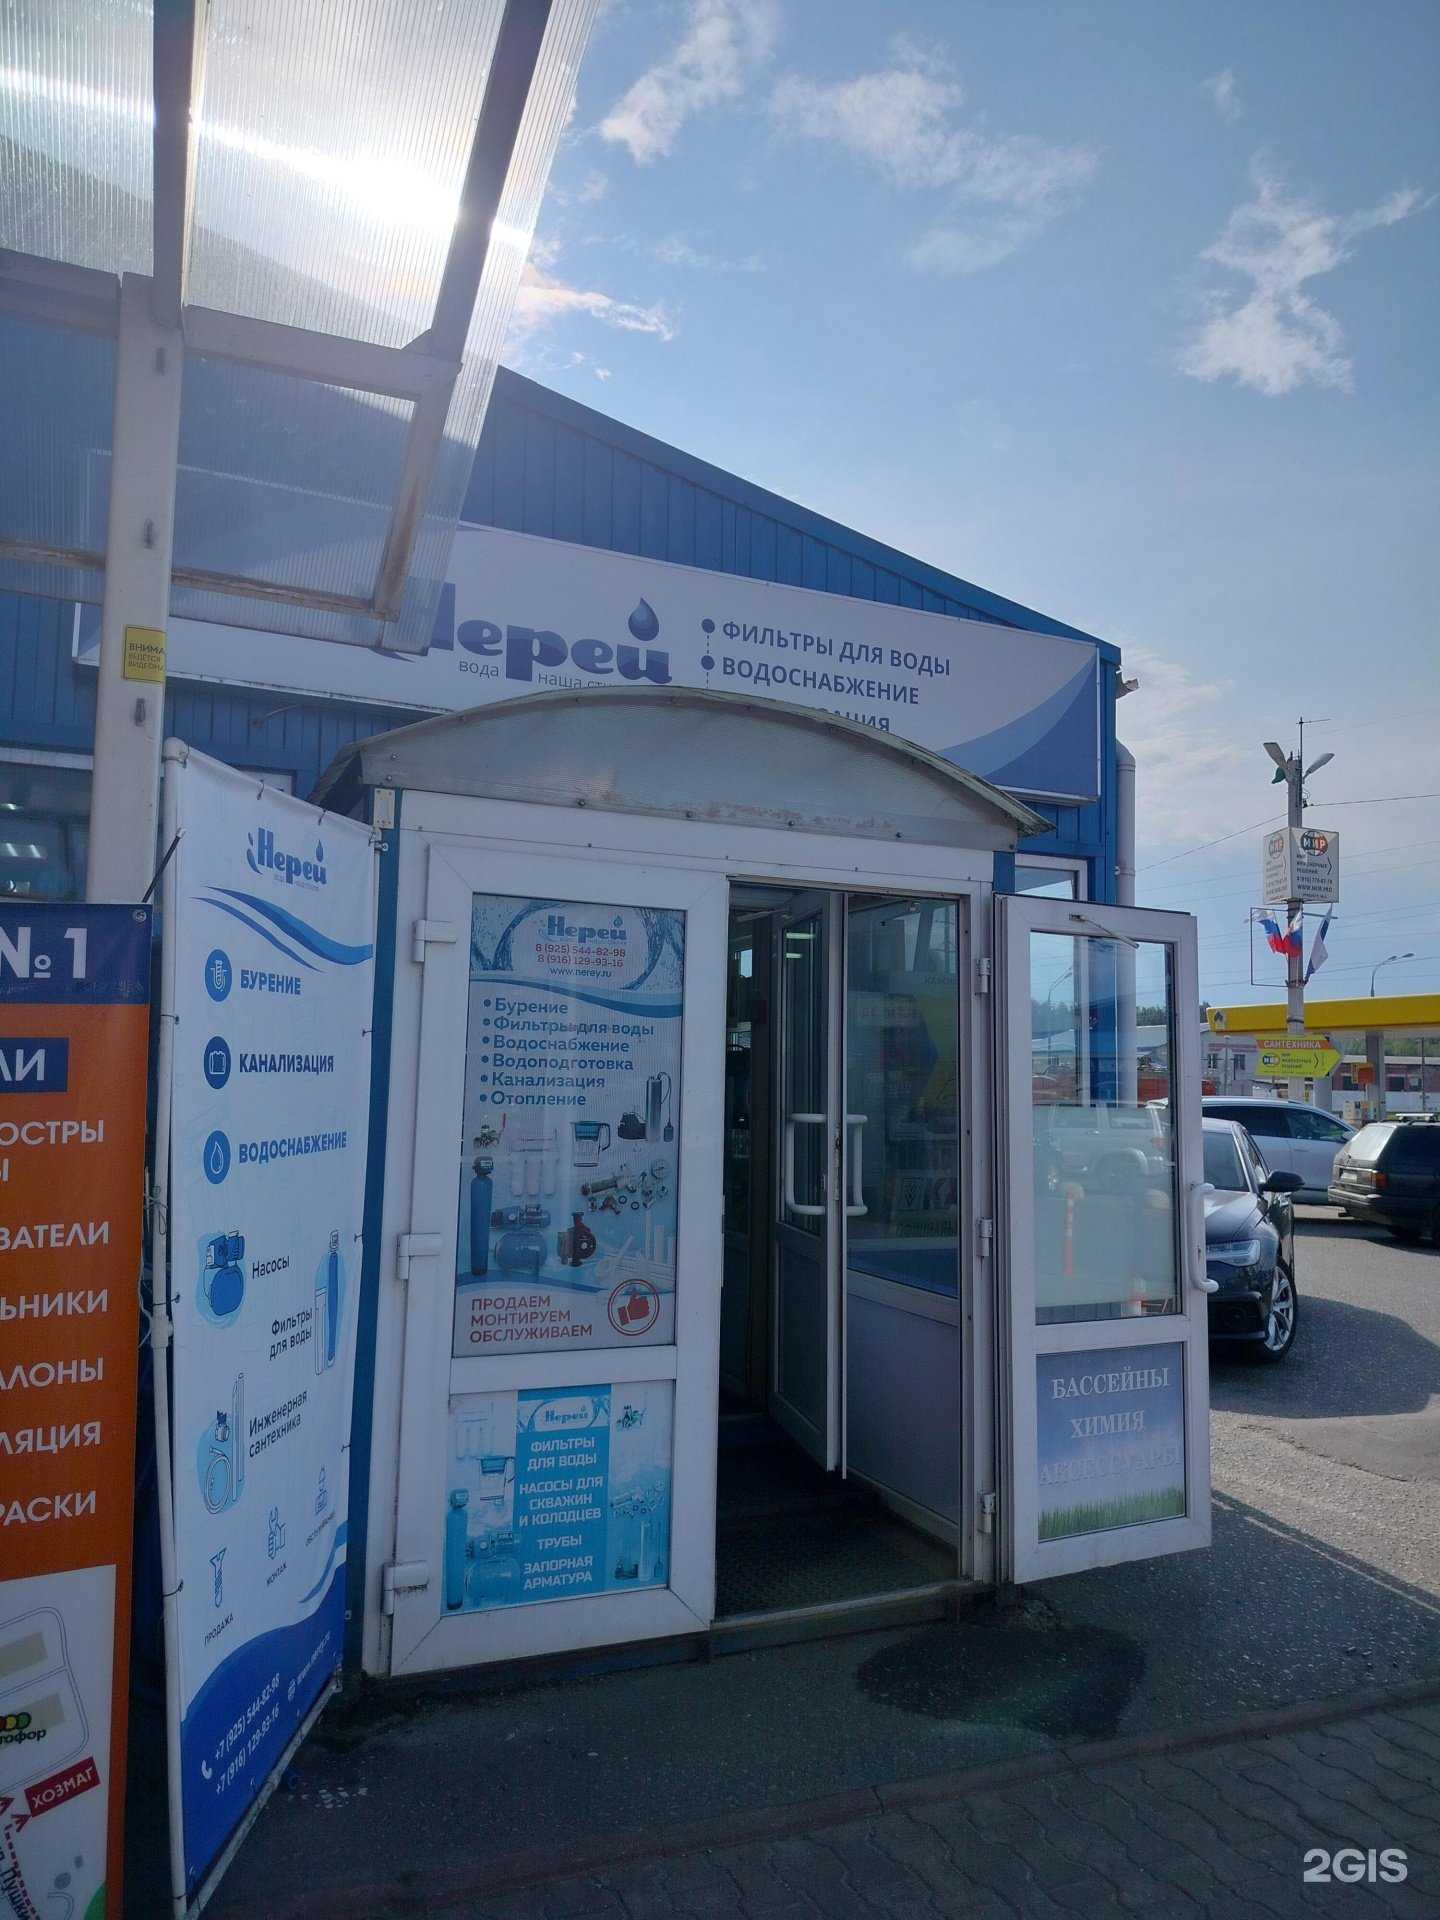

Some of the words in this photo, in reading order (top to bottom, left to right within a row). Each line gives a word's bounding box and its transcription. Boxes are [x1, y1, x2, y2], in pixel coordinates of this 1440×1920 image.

[723, 621, 833, 656] ФИЛЬТРЫ
[839, 641, 883, 665] ДЛЯ
[890, 649, 950, 677] ВОДЫ
[459, 660, 499, 677] вода
[538, 672, 582, 689] наша
[722, 656, 919, 705] ВОДОСНАБЖЕНИЕ
[258, 827, 327, 885] Нерей
[548, 914, 627, 943] Нерей
[64, 928, 87, 979] 1
[545, 944, 570, 954] (925)
[547, 954, 571, 965] (916)
[240, 969, 301, 995] БУРЕНИЕ
[550, 967, 612, 979] www.nerey.ru
[495, 998, 568, 1016] Бурение
[493, 1017, 577, 1035] Фильтры
[577, 1022, 608, 1036] для
[612, 1025, 654, 1037] воды
[493, 1035, 630, 1052] Водоснабжение
[1264, 1040, 1322, 1049] САНТЕХНИКА
[239, 1053, 334, 1076] КАНАЛИЗАЦИЯ
[493, 1053, 633, 1071] Водоподготовка
[492, 1072, 605, 1089] Канализация
[491, 1091, 586, 1106] Отопление
[239, 1130, 347, 1164] ВОДОСНАБЖЕНИЕ
[252, 1255, 290, 1279] Насосы
[472, 1295, 551, 1311] ПРОДАЕМ
[271, 1307, 312, 1336] Фильтры
[471, 1310, 571, 1327] МОНТИРУЕМ
[269, 1340, 288, 1361] для
[290, 1326, 312, 1349] воды
[470, 1324, 592, 1343] ОБСЛУЖИВАЕМ
[1053, 1366, 1171, 1400] БАССЕЙНЫ
[249, 1390, 308, 1437] Инженерная
[1070, 1410, 1145, 1438] ХИМИЯ
[249, 1417, 301, 1458] сантехника
[530, 1436, 595, 1452] ФИЛЬТРЫ
[527, 1456, 555, 1471] ДЛЯ
[559, 1453, 597, 1467] ВОДЫ
[519, 1479, 573, 1494] НАСОСЫ
[575, 1476, 603, 1490] ДЛЯ
[529, 1493, 592, 1510] СКВАЖИН
[519, 1517, 528, 1527] И
[532, 1508, 602, 1526] КОЛОДЦЕВ
[537, 1534, 582, 1550] ТРУБЫ
[523, 1555, 593, 1574] ЗАПОРНАЯ
[523, 1571, 592, 1590] АРМАТУРА
[204, 1613, 234, 1646] ПРОДАЖА
[215, 1740, 225, 1761] +7
[226, 1715, 246, 1752] (925)
[216, 1775, 226, 1795] +7
[227, 1747, 246, 1785] (916)
[248, 1702, 280, 1755] 129-93-16
[32, 1766, 94, 1809] ХОЗМАГ
